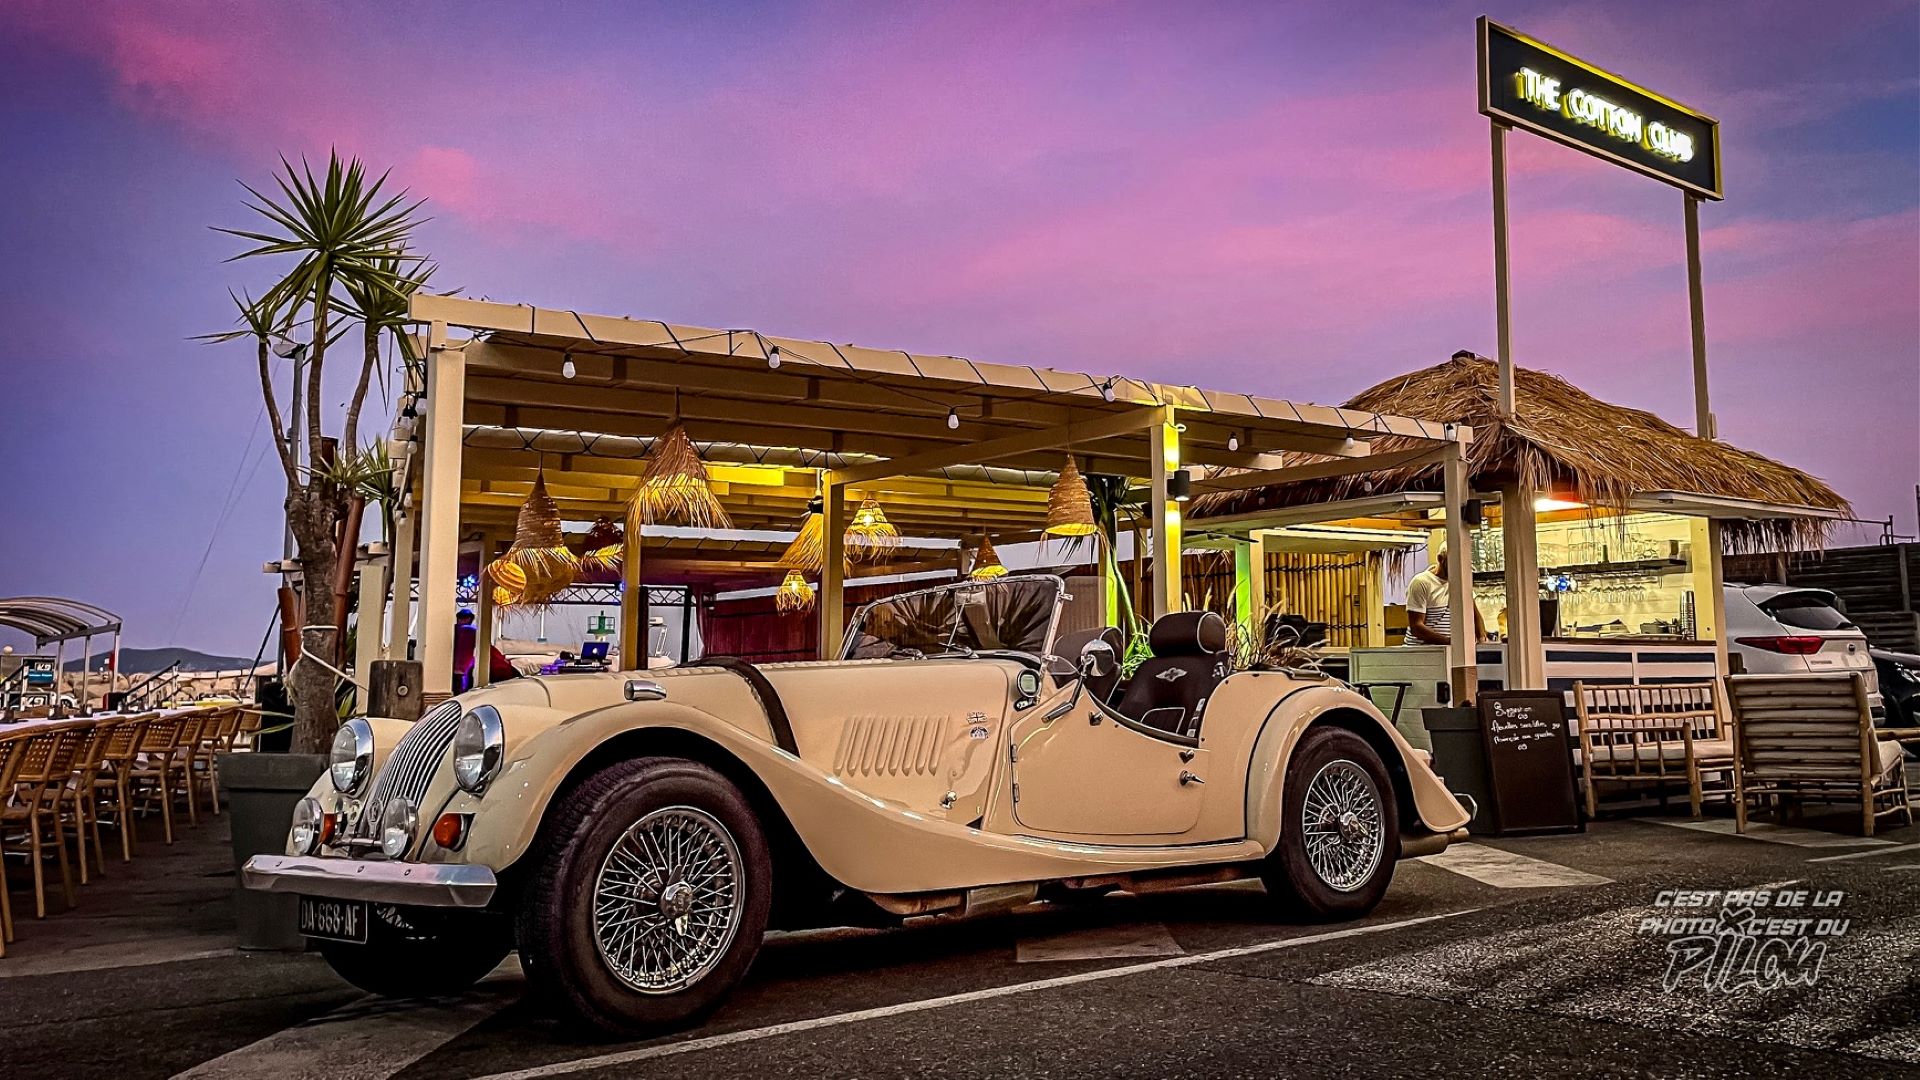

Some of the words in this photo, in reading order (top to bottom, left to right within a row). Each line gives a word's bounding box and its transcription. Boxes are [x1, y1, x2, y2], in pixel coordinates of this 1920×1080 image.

[1517, 66, 1561, 111] THE
[1566, 87, 1642, 143] COTTON
[1648, 120, 1696, 163] CLUB
